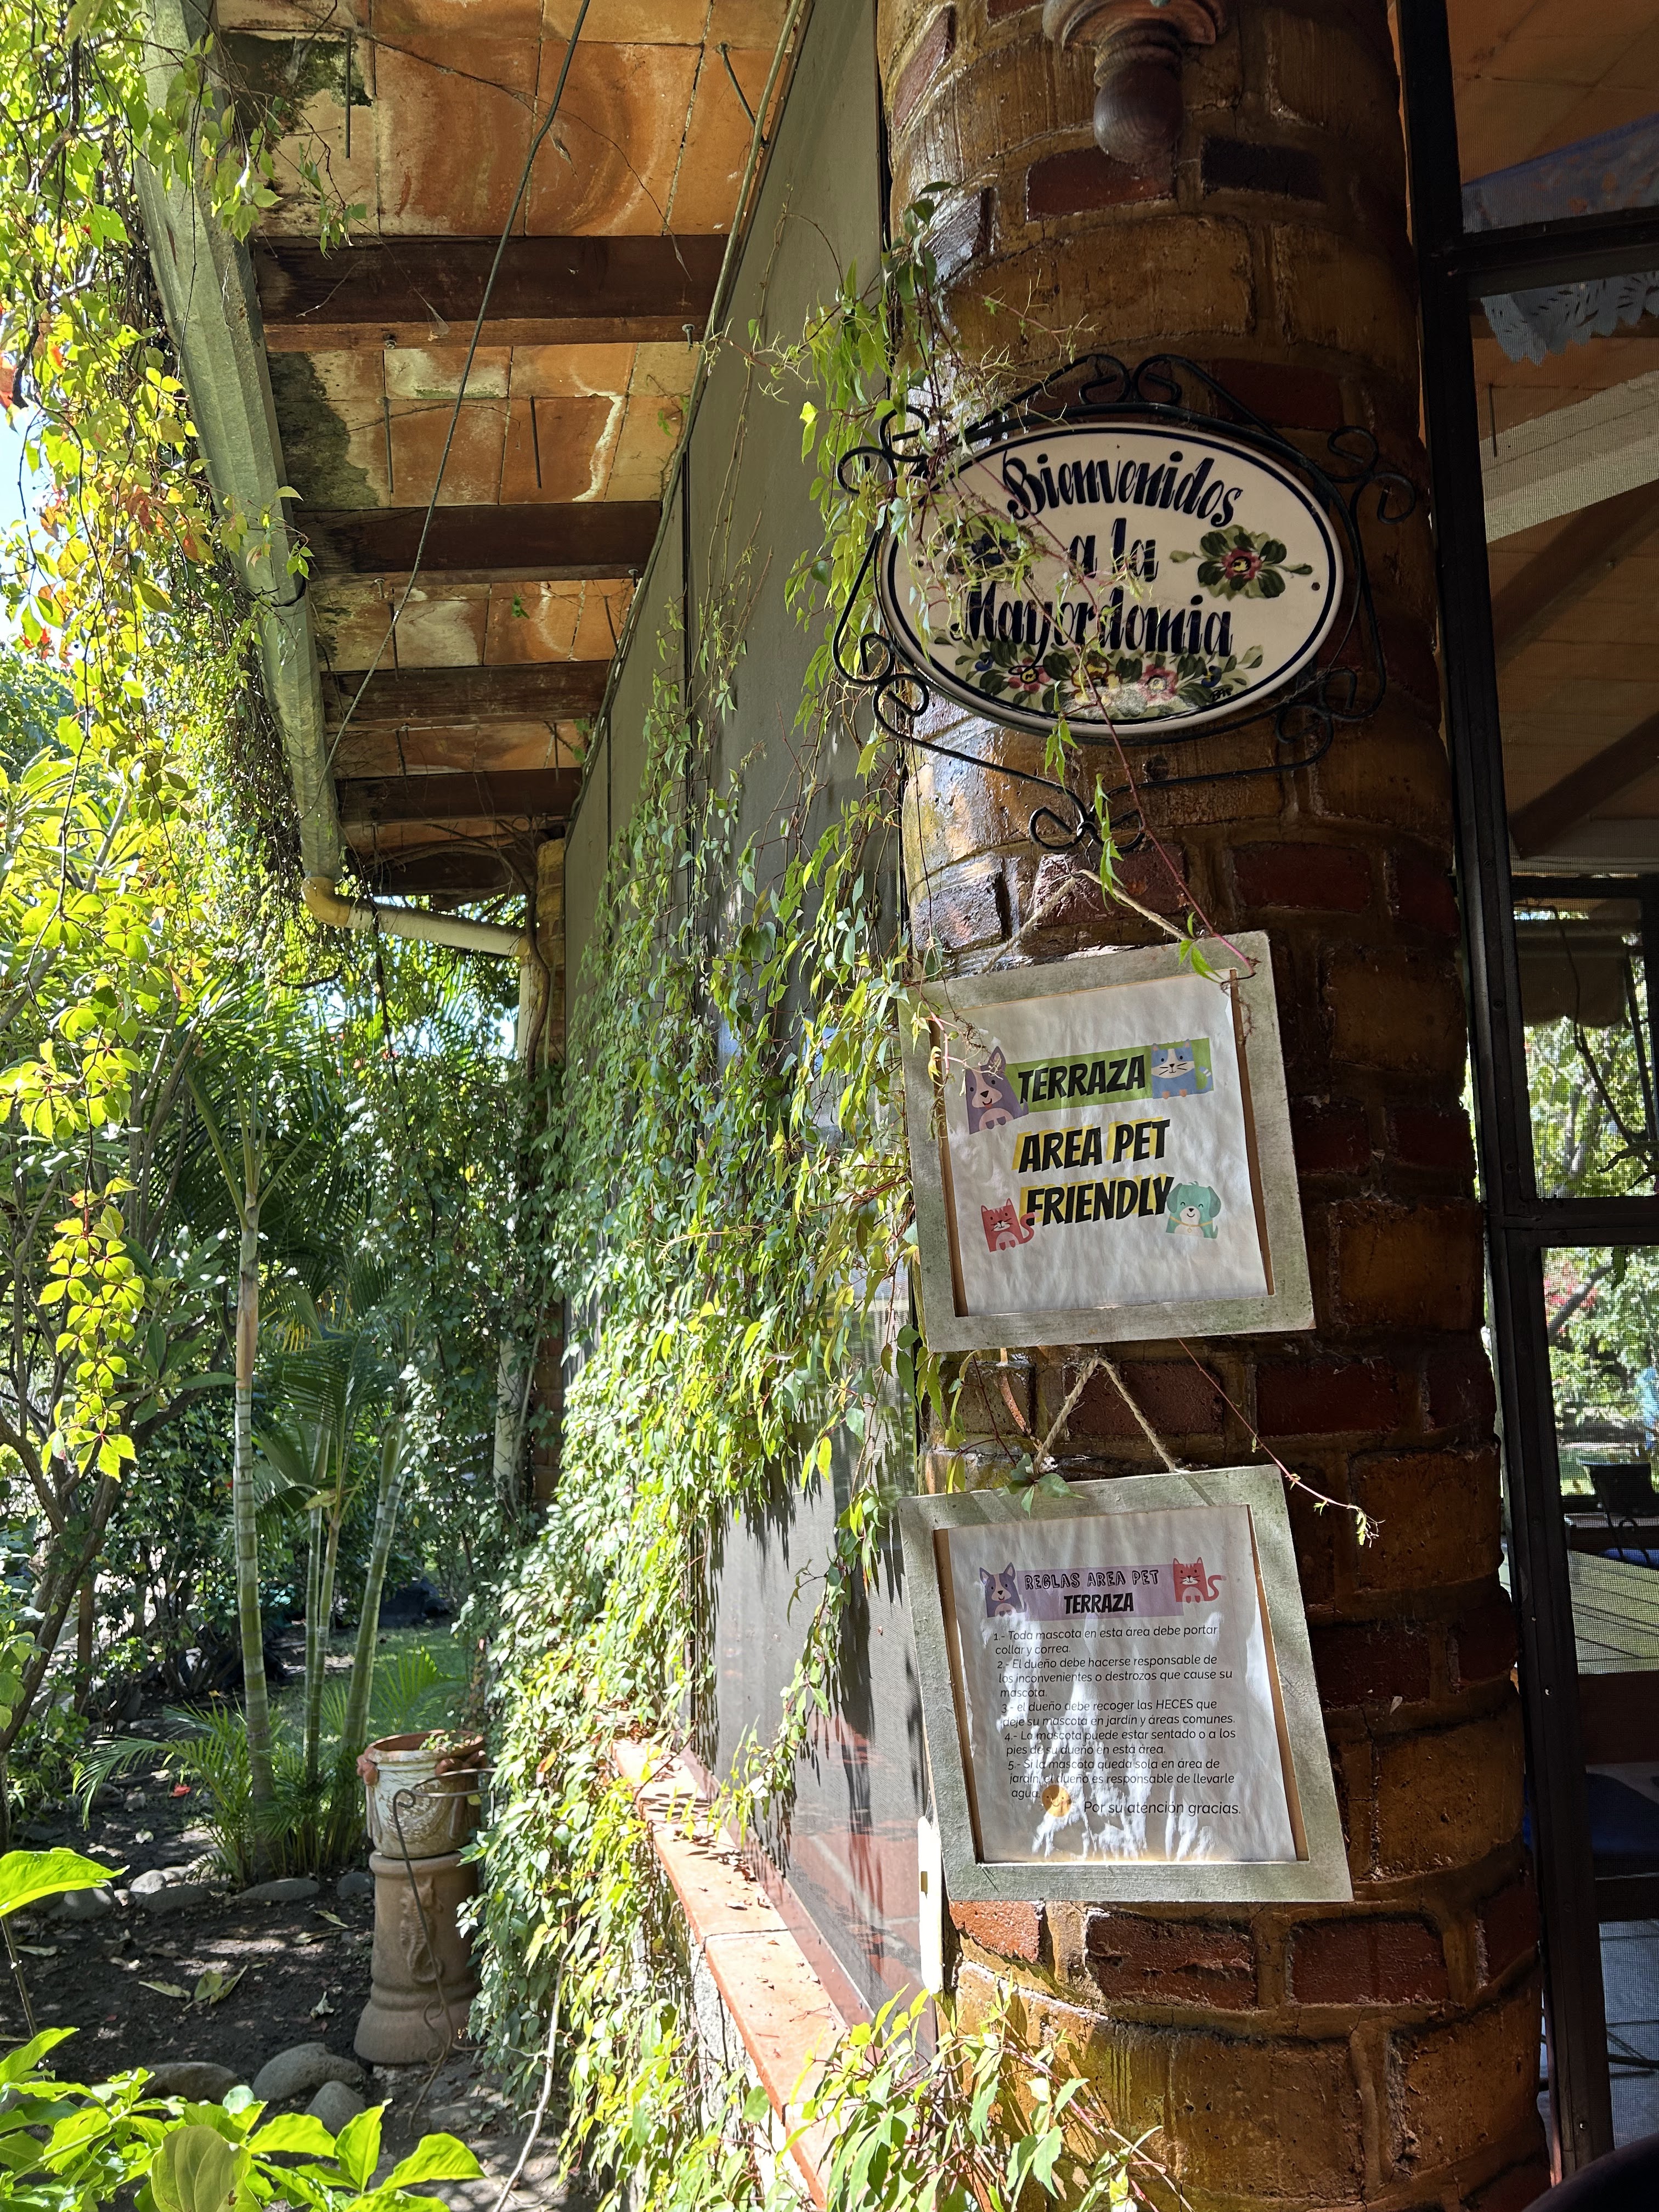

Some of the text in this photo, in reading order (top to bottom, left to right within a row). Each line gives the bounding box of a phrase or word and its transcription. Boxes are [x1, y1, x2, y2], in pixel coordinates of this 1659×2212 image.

[1002, 450, 1243, 527] Bienvenidos
[1068, 517, 1159, 582] a la
[1018, 1054, 1146, 1104] TERRAZA
[1018, 1119, 1170, 1173] AREA PET
[1026, 1176, 1175, 1226] FRIENDLY
[1024, 1570, 1159, 1590] REGLAS AREA PET
[1064, 1593, 1134, 1614] TERRAZA
[1008, 1630, 1033, 1640] Toda
[1036, 1629, 1081, 1639] mascota
[1085, 1630, 1097, 1638] en
[1099, 1628, 1122, 1638] esta
[1126, 1626, 1150, 1636] área
[1153, 1625, 1181, 1636] debe
[1183, 1624, 1218, 1638] portar
[995, 1645, 1071, 1656] collar y correa.
[1013, 1658, 1022, 1669] El
[1024, 1658, 1057, 1669] dueño
[1060, 1657, 1086, 1668] debe
[1088, 1657, 1131, 1667] hacerse
[1133, 1654, 1201, 1667] responsable
[1204, 1654, 1217, 1664] de
[999, 1673, 1013, 1683] los
[1016, 1672, 1092, 1683] inconvenientes
[1105, 1671, 1157, 1681] destrozos
[1160, 1672, 1180, 1682] que
[1183, 1671, 1216, 1680] cause
[1220, 1670, 1232, 1679] su
[1000, 1688, 1047, 1697] mascota.
[1017, 1702, 1026, 1712] el
[1029, 1701, 1061, 1711] dueño
[1065, 1701, 1090, 1711] debe
[1093, 1702, 1135, 1712] recoger
[1137, 1700, 1152, 1709] las
[1156, 1699, 1193, 1709] HECES
[1197, 1701, 1217, 1711] que
[1003, 1717, 1025, 1728] deje
[1042, 1716, 1087, 1726] mascota
[1105, 1714, 1137, 1727] jardín
[1139, 1717, 1146, 1727] y
[1148, 1714, 1180, 1724] áreas
[1183, 1715, 1235, 1724] comunes.
[1005, 1728, 1236, 1741] 4.- La mascota puede estar sentado o a los
[1006, 1745, 1027, 1757] pies
[1030, 1745, 1043, 1754] de
[1060, 1744, 1093, 1754] dueño
[1097, 1746, 1109, 1754] en
[1139, 1744, 1166, 1754] área.
[1008, 1758, 1220, 1770] 5.- Si la mascota queda sola en área de
[1044, 1774, 1053, 1783] el
[1057, 1773, 1089, 1784] dueño
[1107, 1773, 1173, 1786] responsable
[1176, 1773, 1190, 1783] de
[1193, 1773, 1235, 1784] llevarle
[1012, 1790, 1040, 1800] agua.
[1084, 1801, 1241, 1816] Por su atención gracias.
